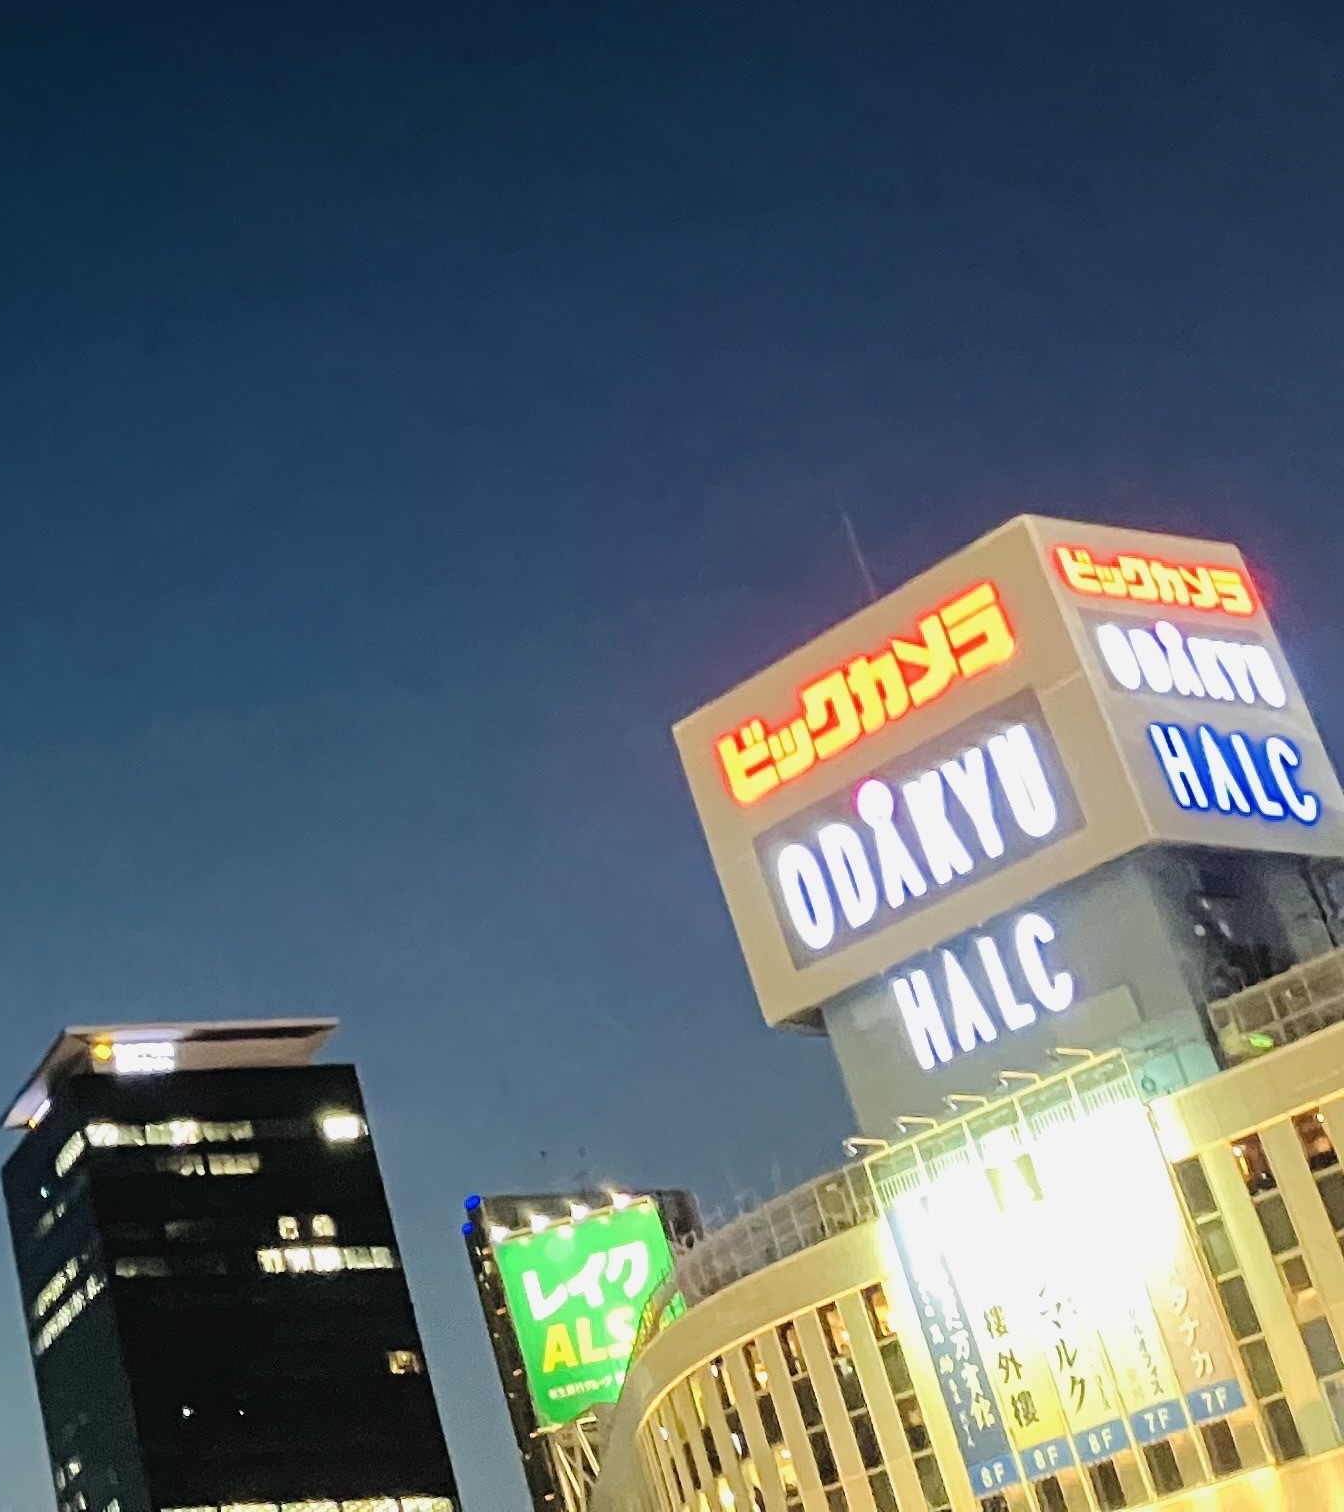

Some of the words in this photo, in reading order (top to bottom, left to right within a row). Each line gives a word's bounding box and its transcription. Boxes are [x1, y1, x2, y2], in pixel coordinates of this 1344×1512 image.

[1055, 545, 1256, 616] ビックカメラ
[717, 581, 1017, 805] ビックカメラ
[1097, 620, 1286, 709] ODAKYU
[1148, 722, 1320, 825] HALC
[776, 722, 1057, 950] ODAKYU
[891, 912, 1074, 1071] HALC
[522, 1240, 649, 1321] レイク
[1143, 1407, 1170, 1434] 7F
[1200, 1386, 1228, 1415] 7F
